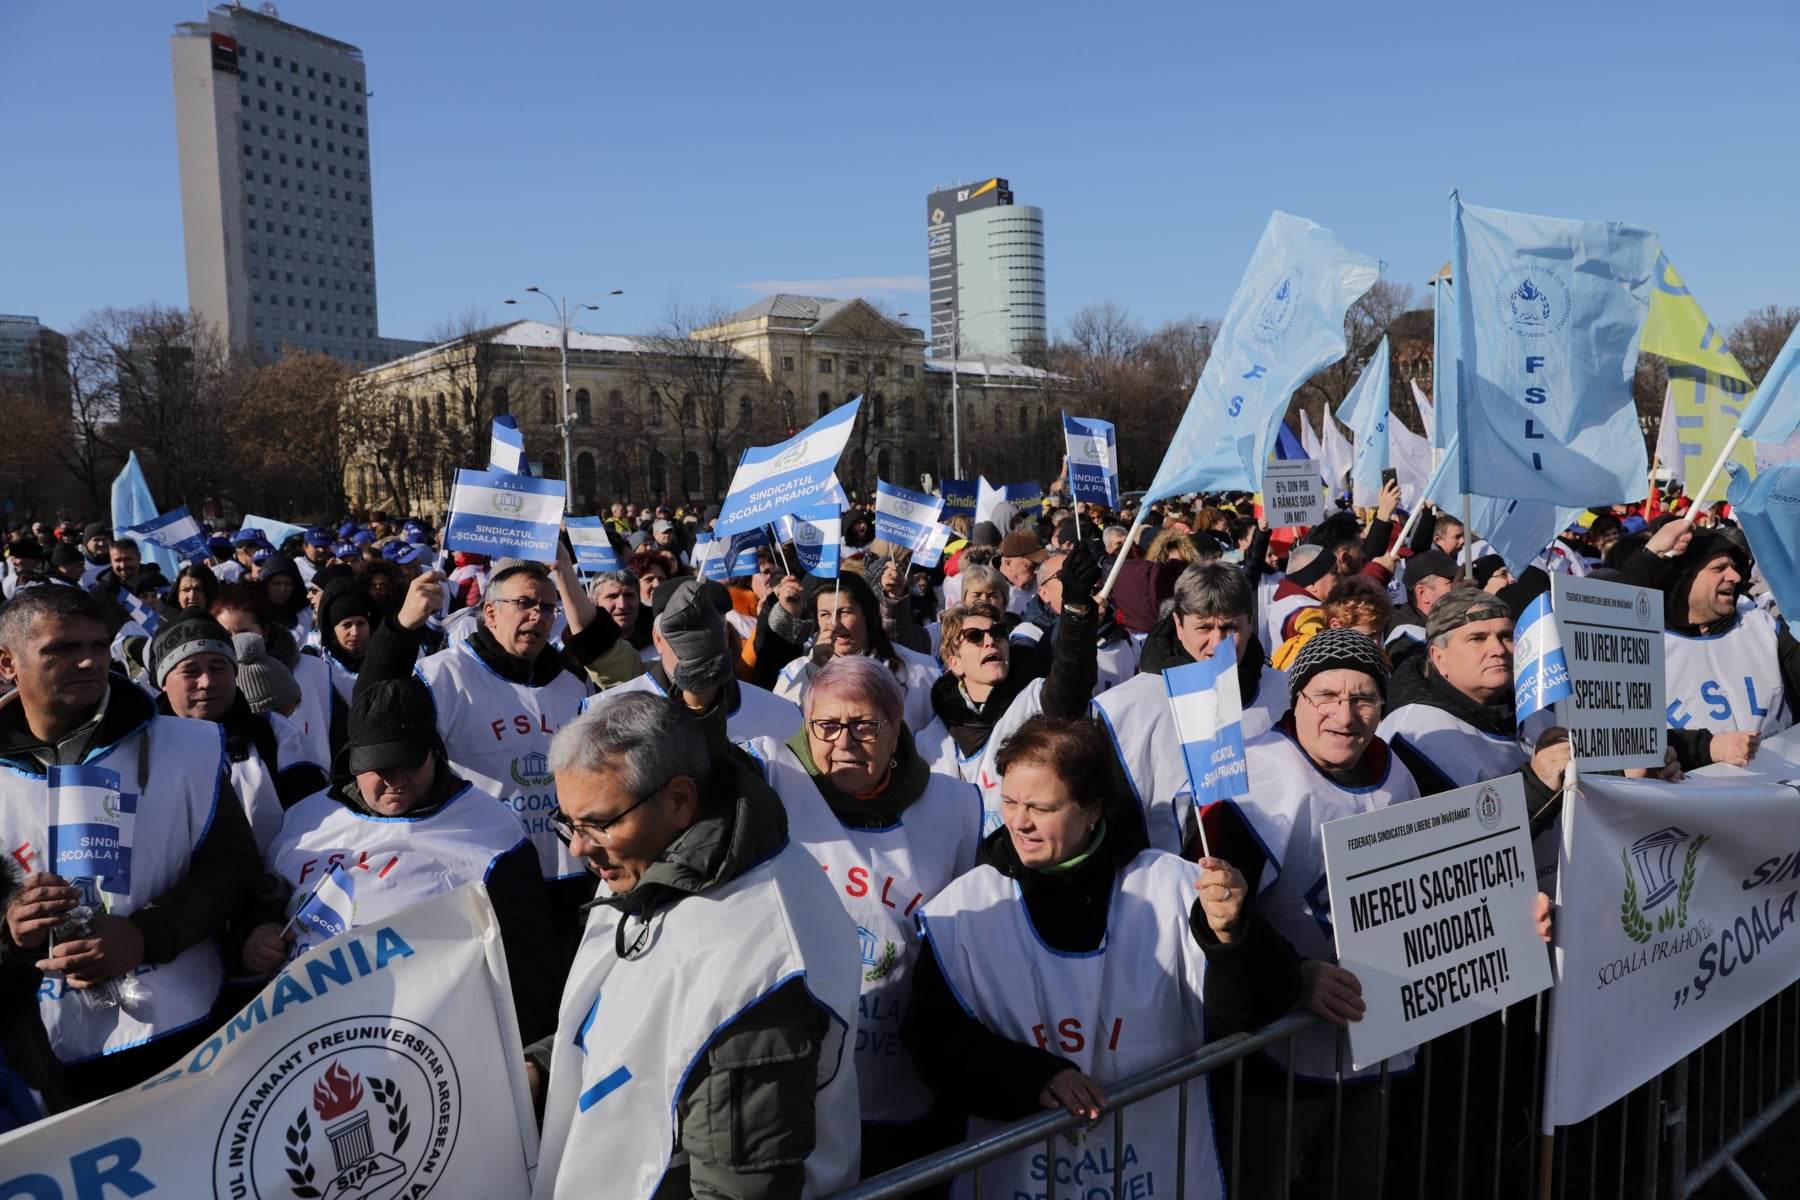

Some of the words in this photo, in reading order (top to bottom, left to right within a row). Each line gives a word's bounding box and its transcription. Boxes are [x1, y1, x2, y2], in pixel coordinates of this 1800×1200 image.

[958, 190, 969, 202] EY
[749, 474, 815, 503] SINDICATUL
[1276, 481, 1287, 493] 6%
[1288, 480, 1298, 493] DIN
[1299, 479, 1310, 492] PIB
[1272, 497, 1277, 509] A
[1300, 495, 1316, 507] DOAR
[475, 525, 534, 539] SINDICATUL
[1284, 512, 1293, 524] UN
[1574, 631, 1588, 661] NU
[1590, 632, 1619, 663] VREM
[1621, 635, 1650, 665] PENSII
[1575, 679, 1625, 714] SPECIALE,
[1626, 681, 1651, 710] VREM
[491, 714, 560, 741] FSL
[1572, 727, 1610, 758] SALARII
[1612, 727, 1658, 757] NORMALE!
[1414, 818, 1431, 833] LIBERE
[1349, 878, 1418, 933] MEREU
[1419, 846, 1525, 910] SACRIFICAȚI,
[1403, 897, 1495, 968] NICIODATĂ
[1400, 947, 1511, 1023] RESPECTAȚI!
[1598, 949, 1648, 990] SCOALA
[141, 926, 416, 1091] ROMÂNIA
[229, 1051, 302, 1169] INVATAMANT
[308, 1026, 445, 1079] PREUNIVERSITAR
[422, 1080, 450, 1174] ARGESEAN
[336, 1159, 380, 1191] SIPA
